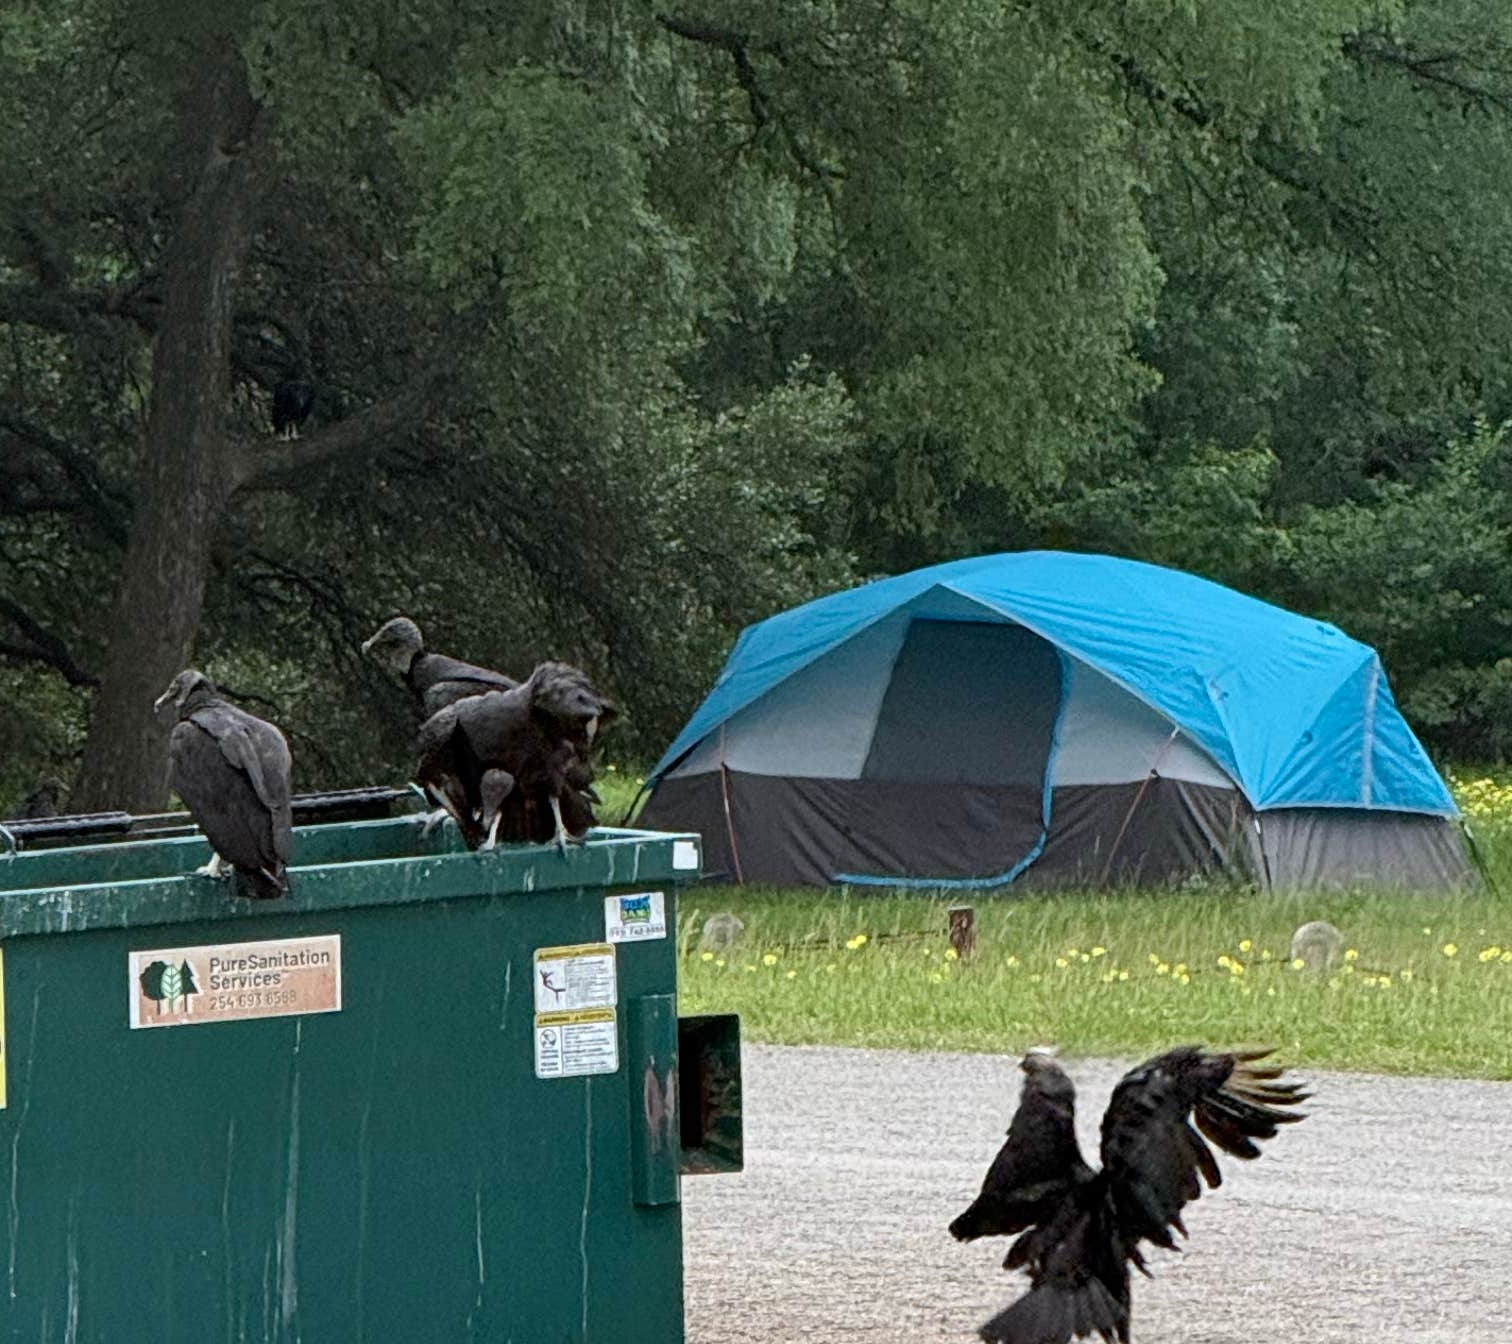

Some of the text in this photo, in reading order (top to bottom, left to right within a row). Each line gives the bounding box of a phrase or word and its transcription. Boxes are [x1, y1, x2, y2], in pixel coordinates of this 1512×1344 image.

[209, 950, 330, 973] PureSanitation
[210, 972, 281, 990] Services
[209, 996, 234, 1010] 254
